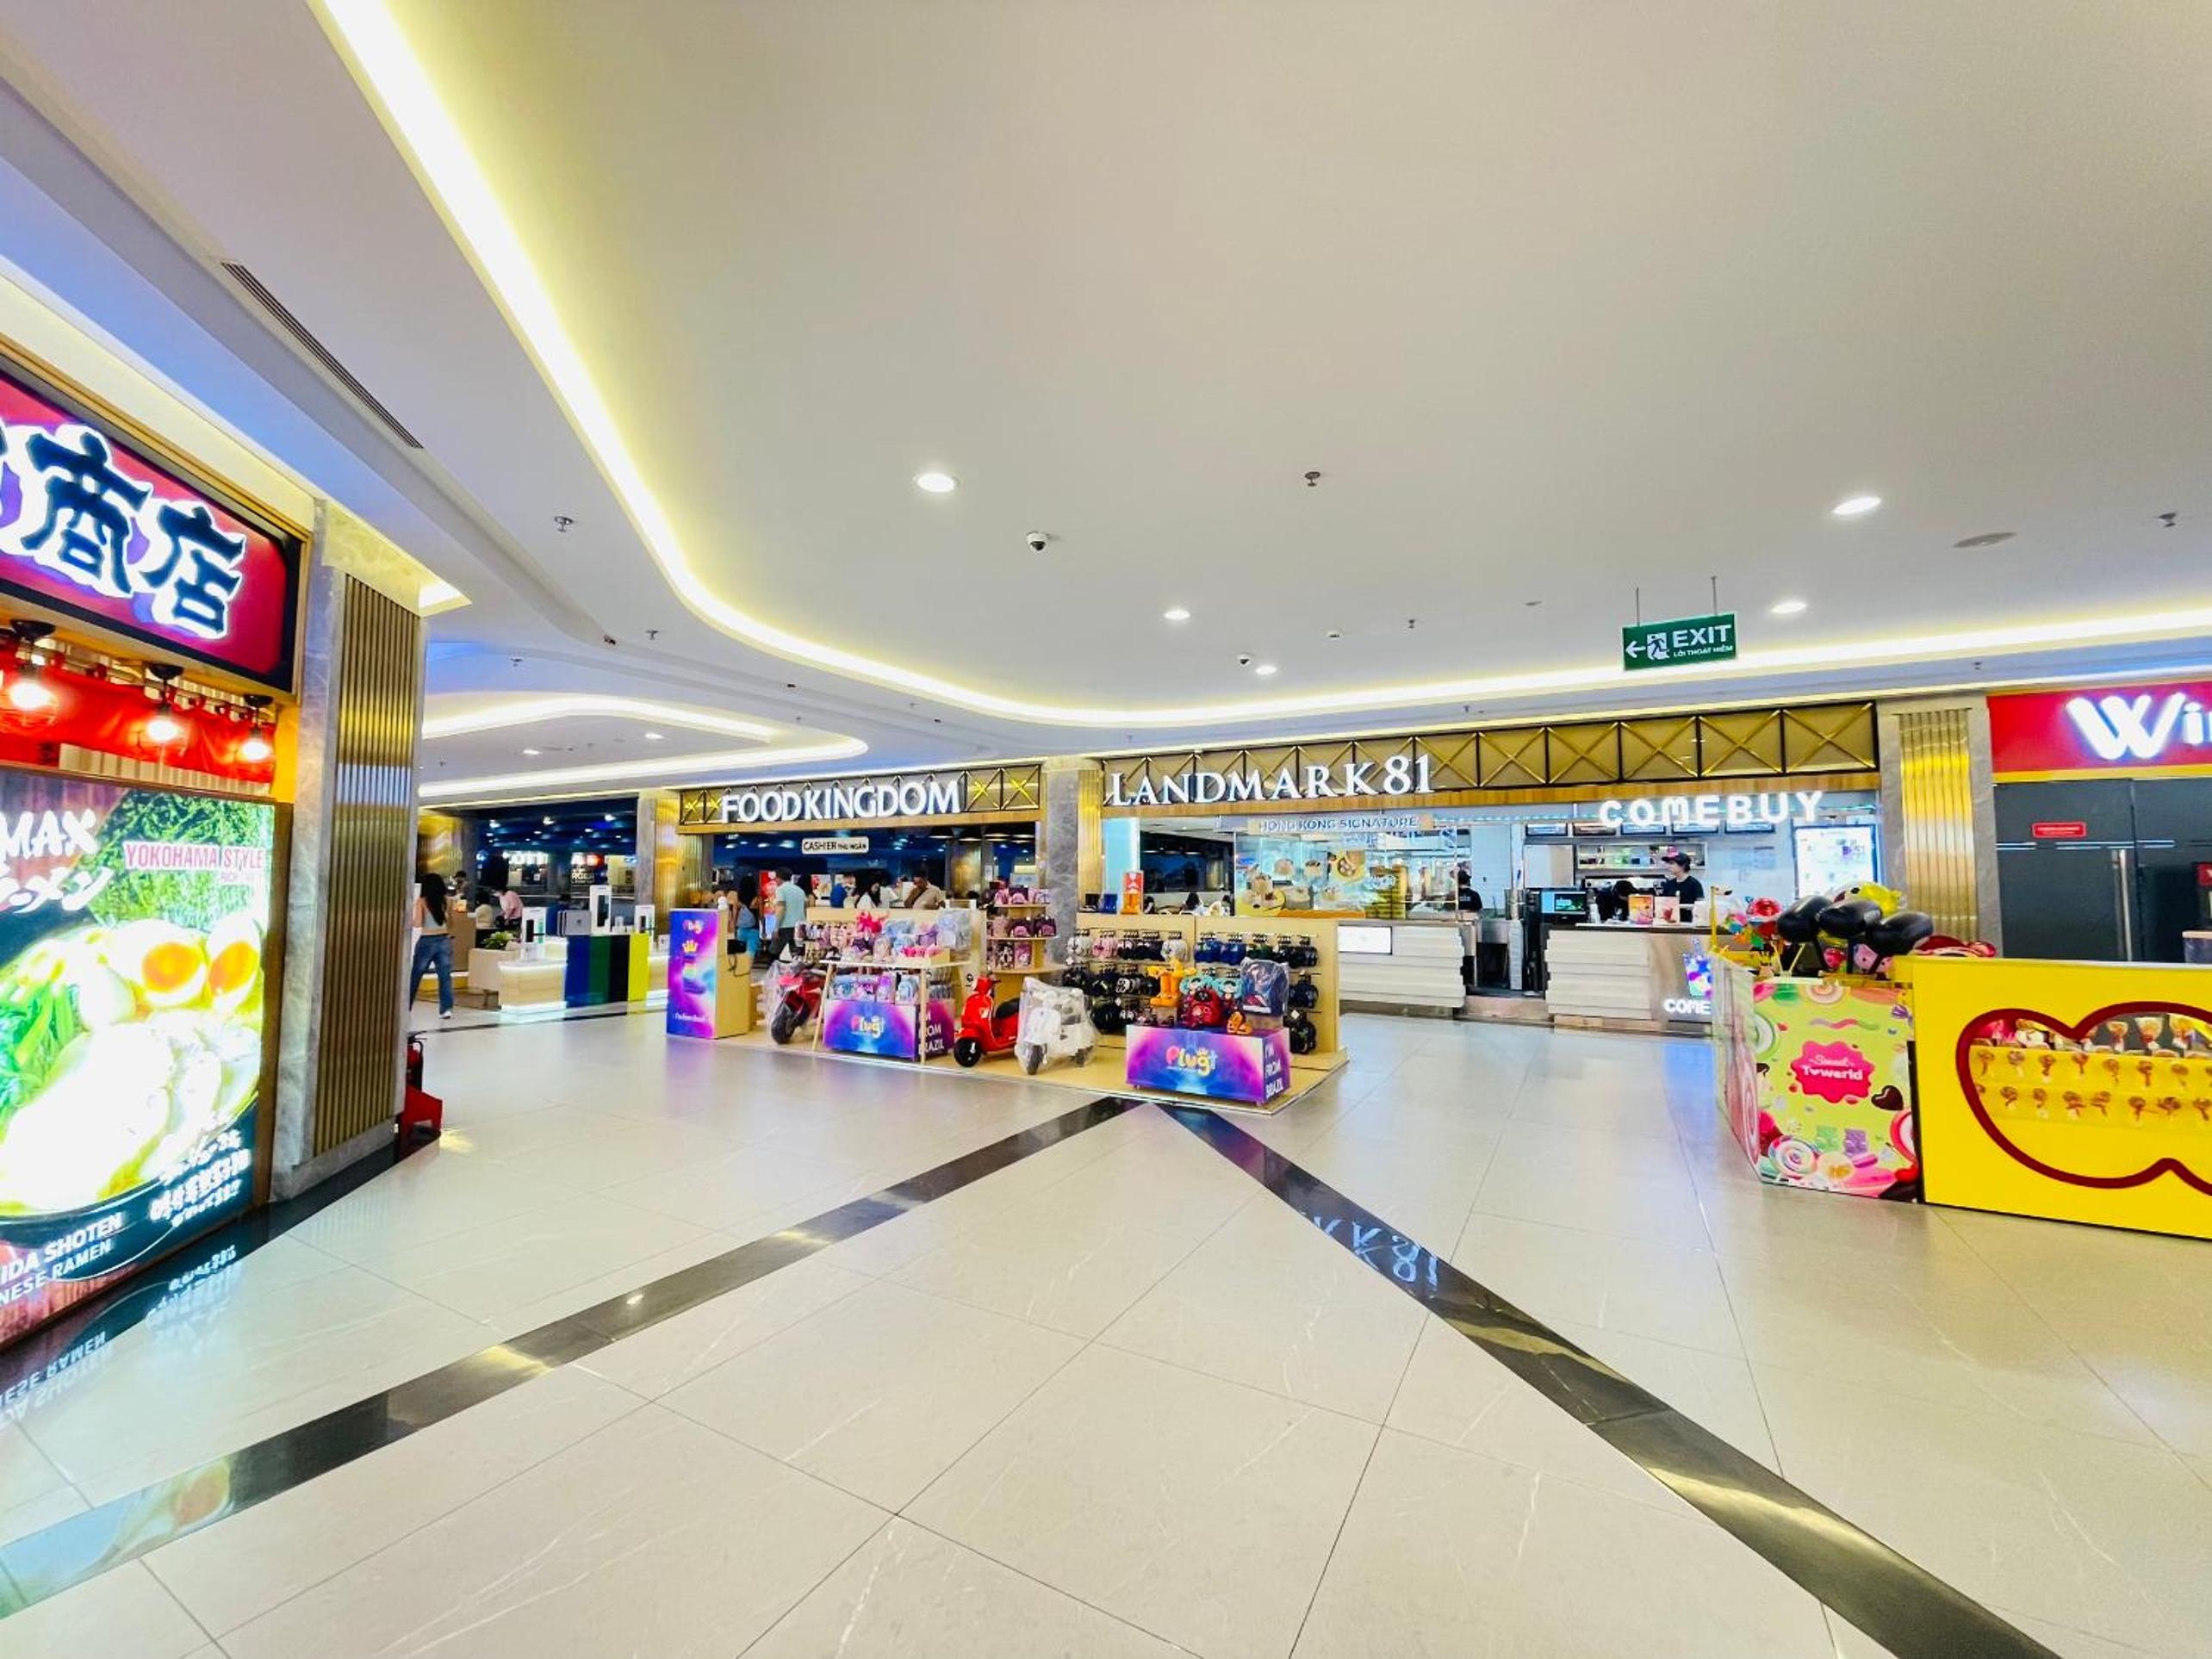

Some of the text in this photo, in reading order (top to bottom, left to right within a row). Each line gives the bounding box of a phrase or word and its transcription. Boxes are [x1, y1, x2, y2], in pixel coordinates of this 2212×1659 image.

[0, 429, 245, 636] 商店
[1673, 624, 1731, 648] EXIT
[2066, 693, 2212, 760] Wi
[1339, 817, 1419, 830] SIGNATURE
[1598, 791, 1824, 829] COMEBUY
[0, 808, 100, 860] MAX
[127, 843, 263, 869] YOKOHAMA STYLE
[44, 1211, 125, 1263] SHOTEN
[52, 1238, 112, 1279] RAMEN
